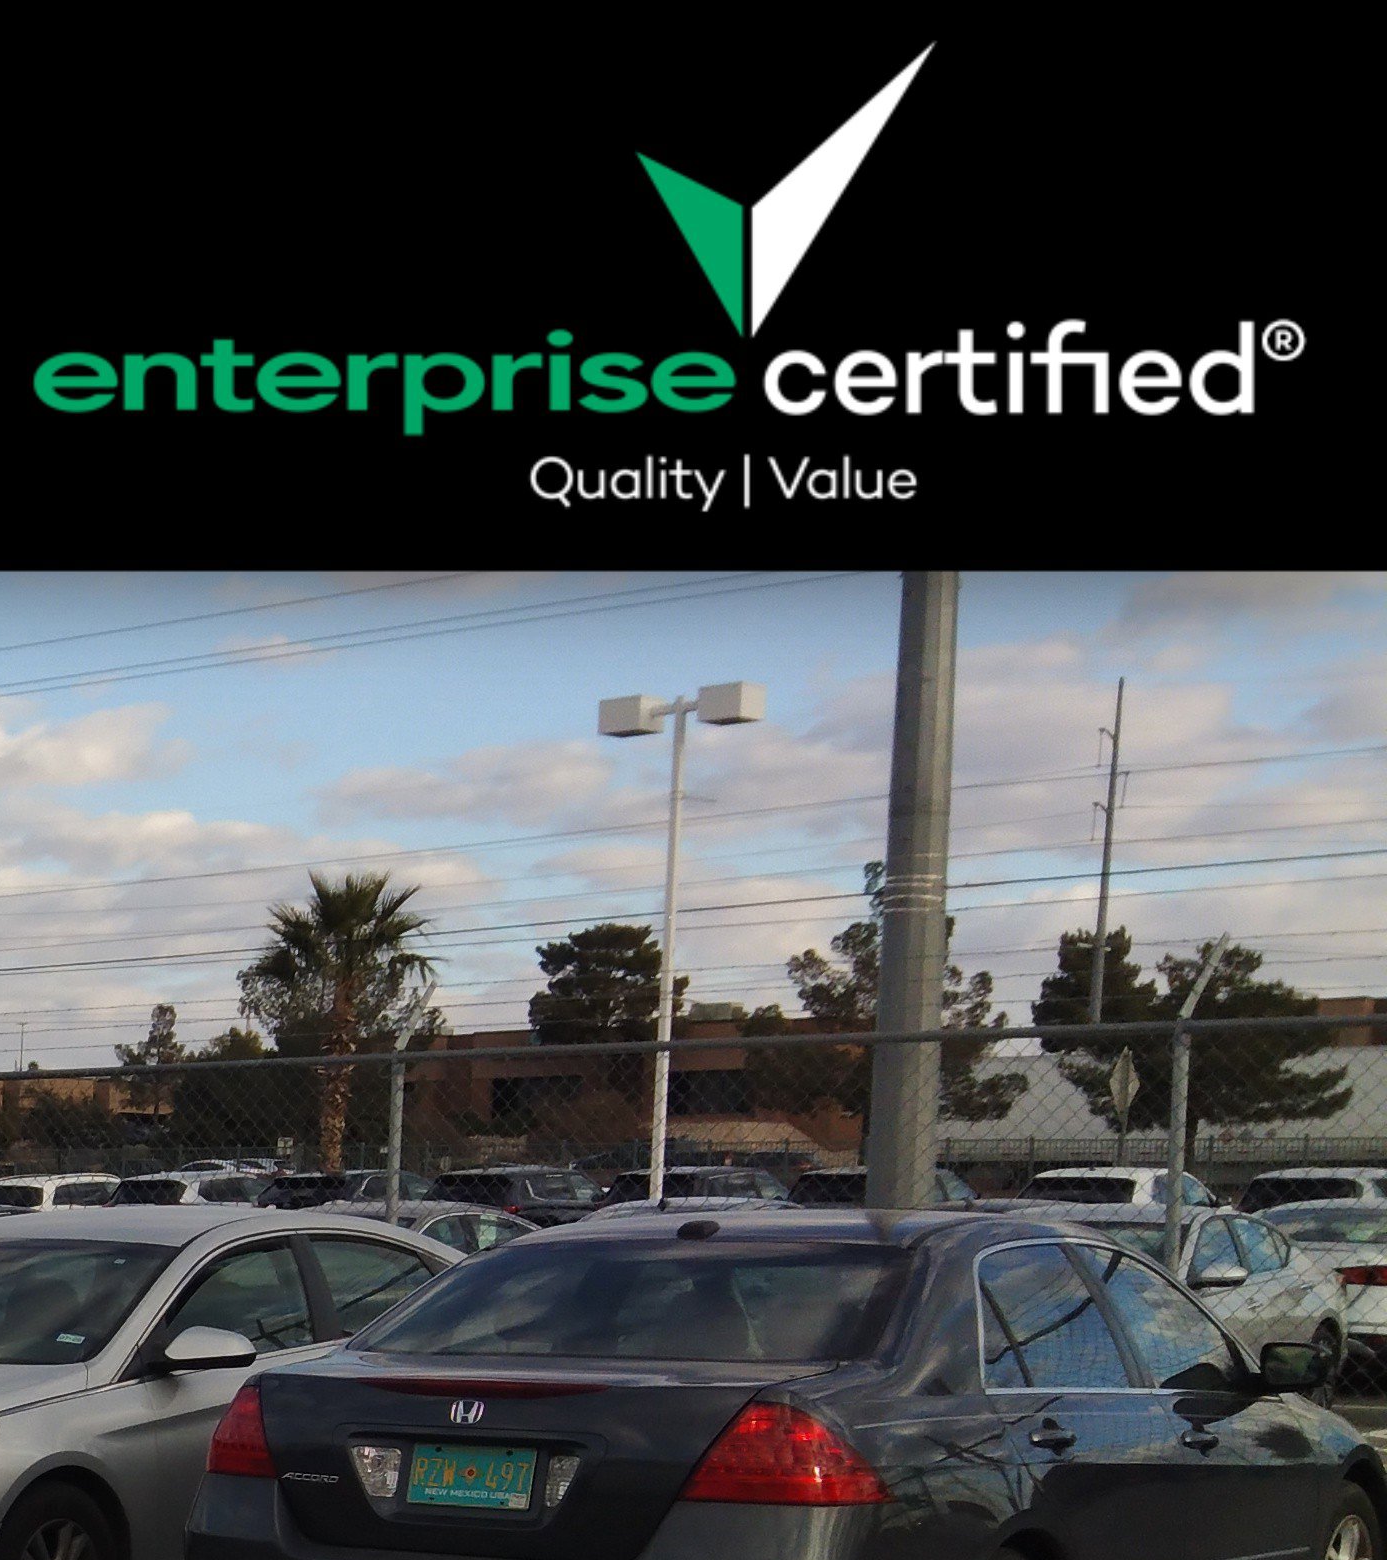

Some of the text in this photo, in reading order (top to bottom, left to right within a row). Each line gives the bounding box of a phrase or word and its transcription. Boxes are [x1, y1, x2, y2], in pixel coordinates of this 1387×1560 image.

[280, 1471, 340, 1483] ACCORD
[424, 1487, 448, 1497] NEW
[450, 1489, 488, 1499] MEXICO
